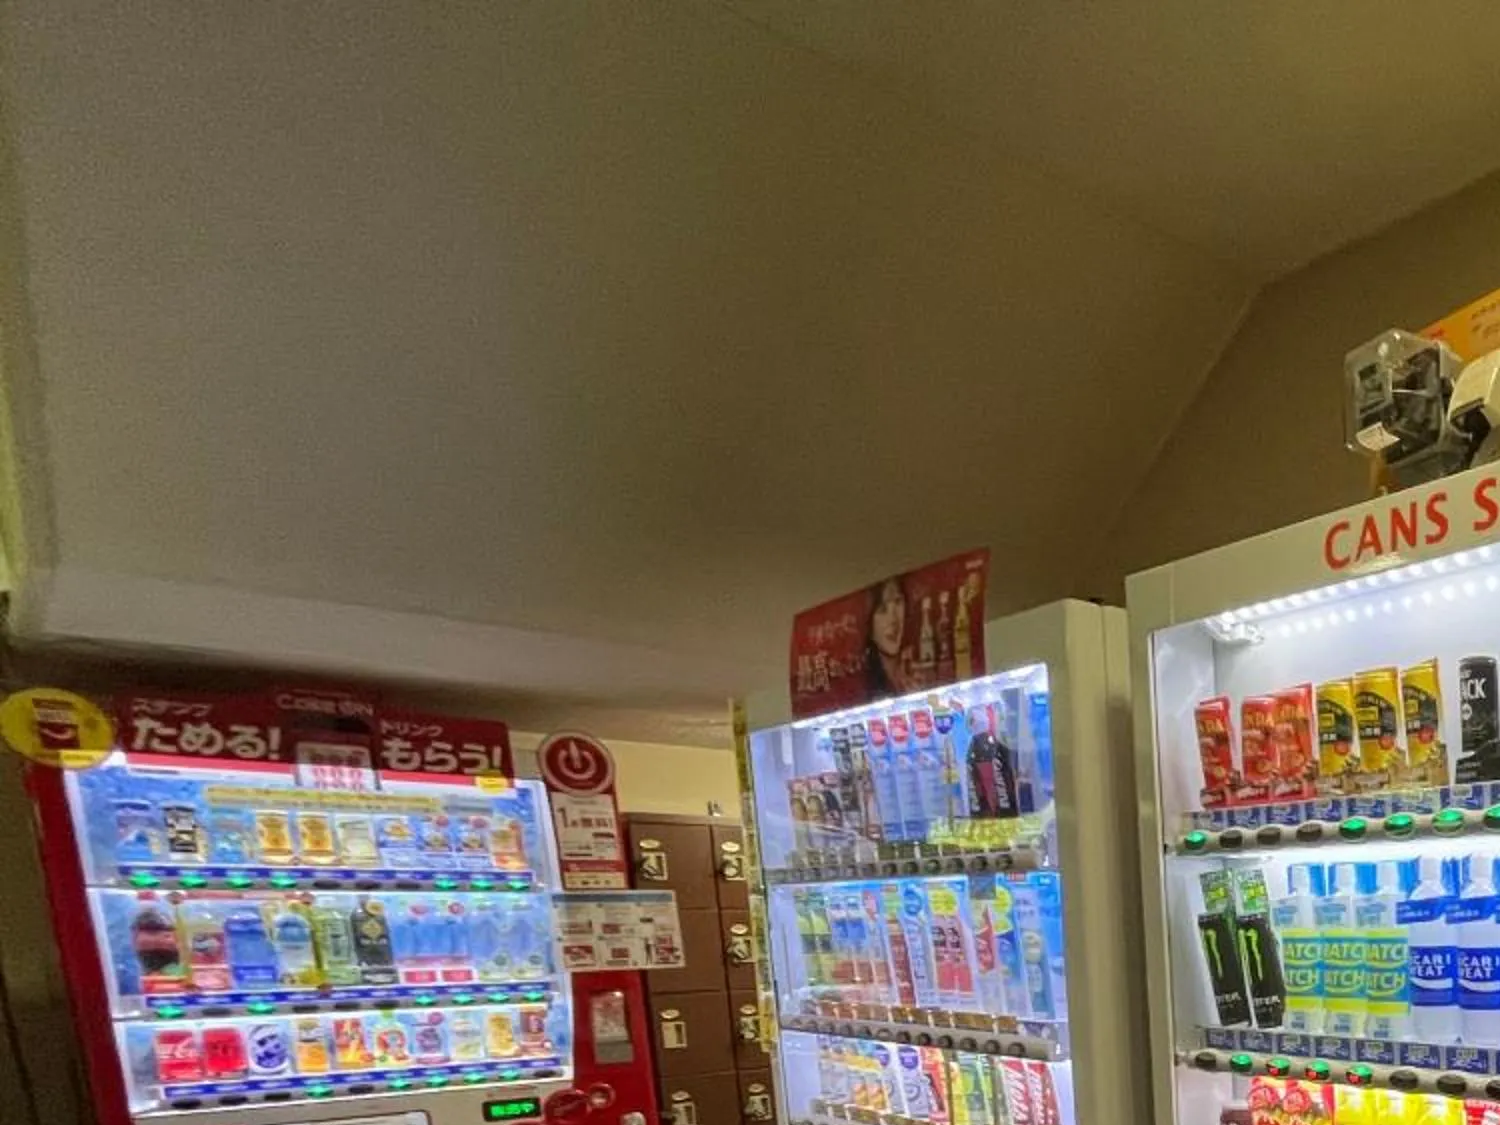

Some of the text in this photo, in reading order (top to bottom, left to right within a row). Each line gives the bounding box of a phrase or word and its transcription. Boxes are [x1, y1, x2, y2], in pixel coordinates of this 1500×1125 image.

[1324, 493, 1450, 570] CANS
[1460, 678, 1486, 699] ACK
[131, 717, 281, 761] ためる!
[381, 738, 502, 776] もらう!
